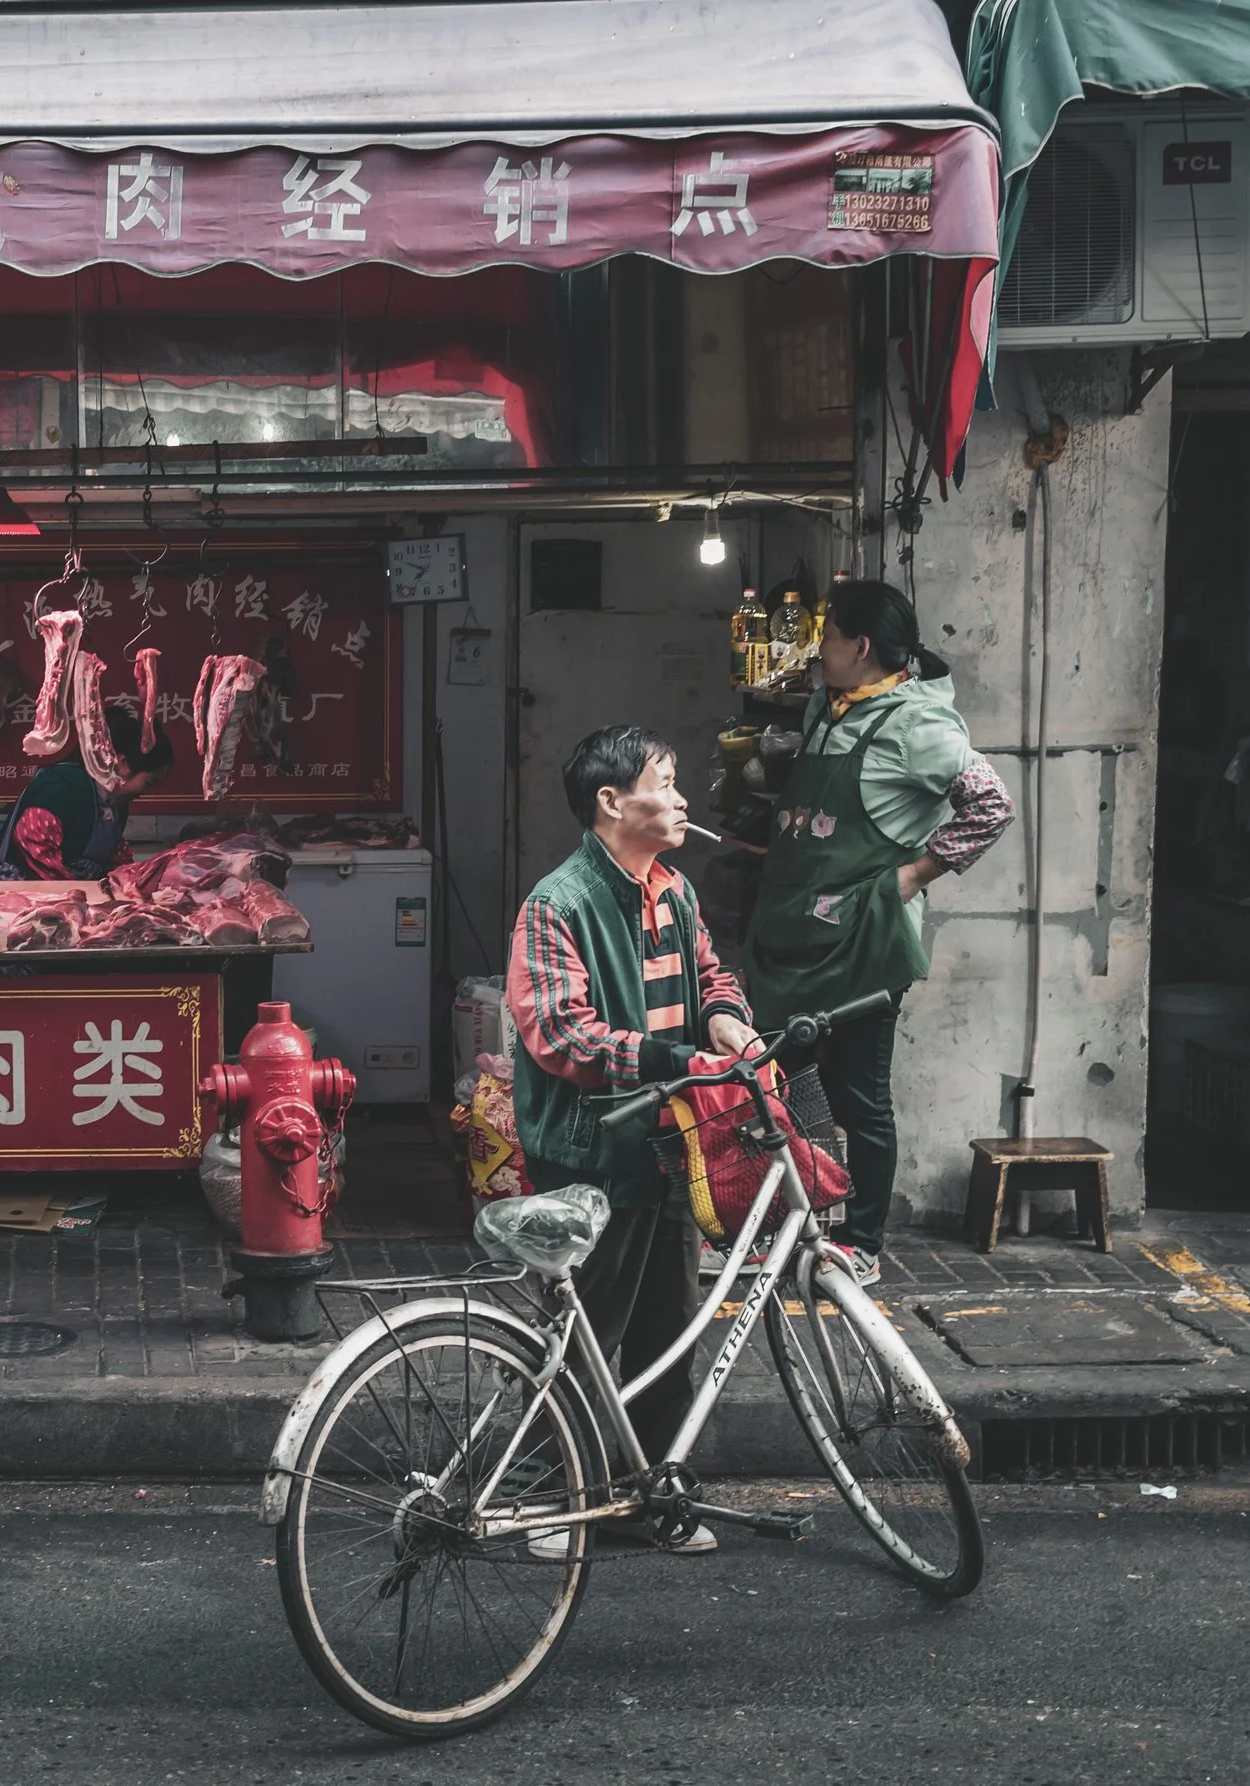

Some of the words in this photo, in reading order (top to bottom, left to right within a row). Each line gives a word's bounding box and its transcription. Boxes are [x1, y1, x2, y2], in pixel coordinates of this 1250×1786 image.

[1173, 155, 1221, 172] TCL
[845, 194, 930, 211] 13023271310
[844, 212, 929, 229] 13651675266
[712, 1272, 772, 1387] ATHENA
